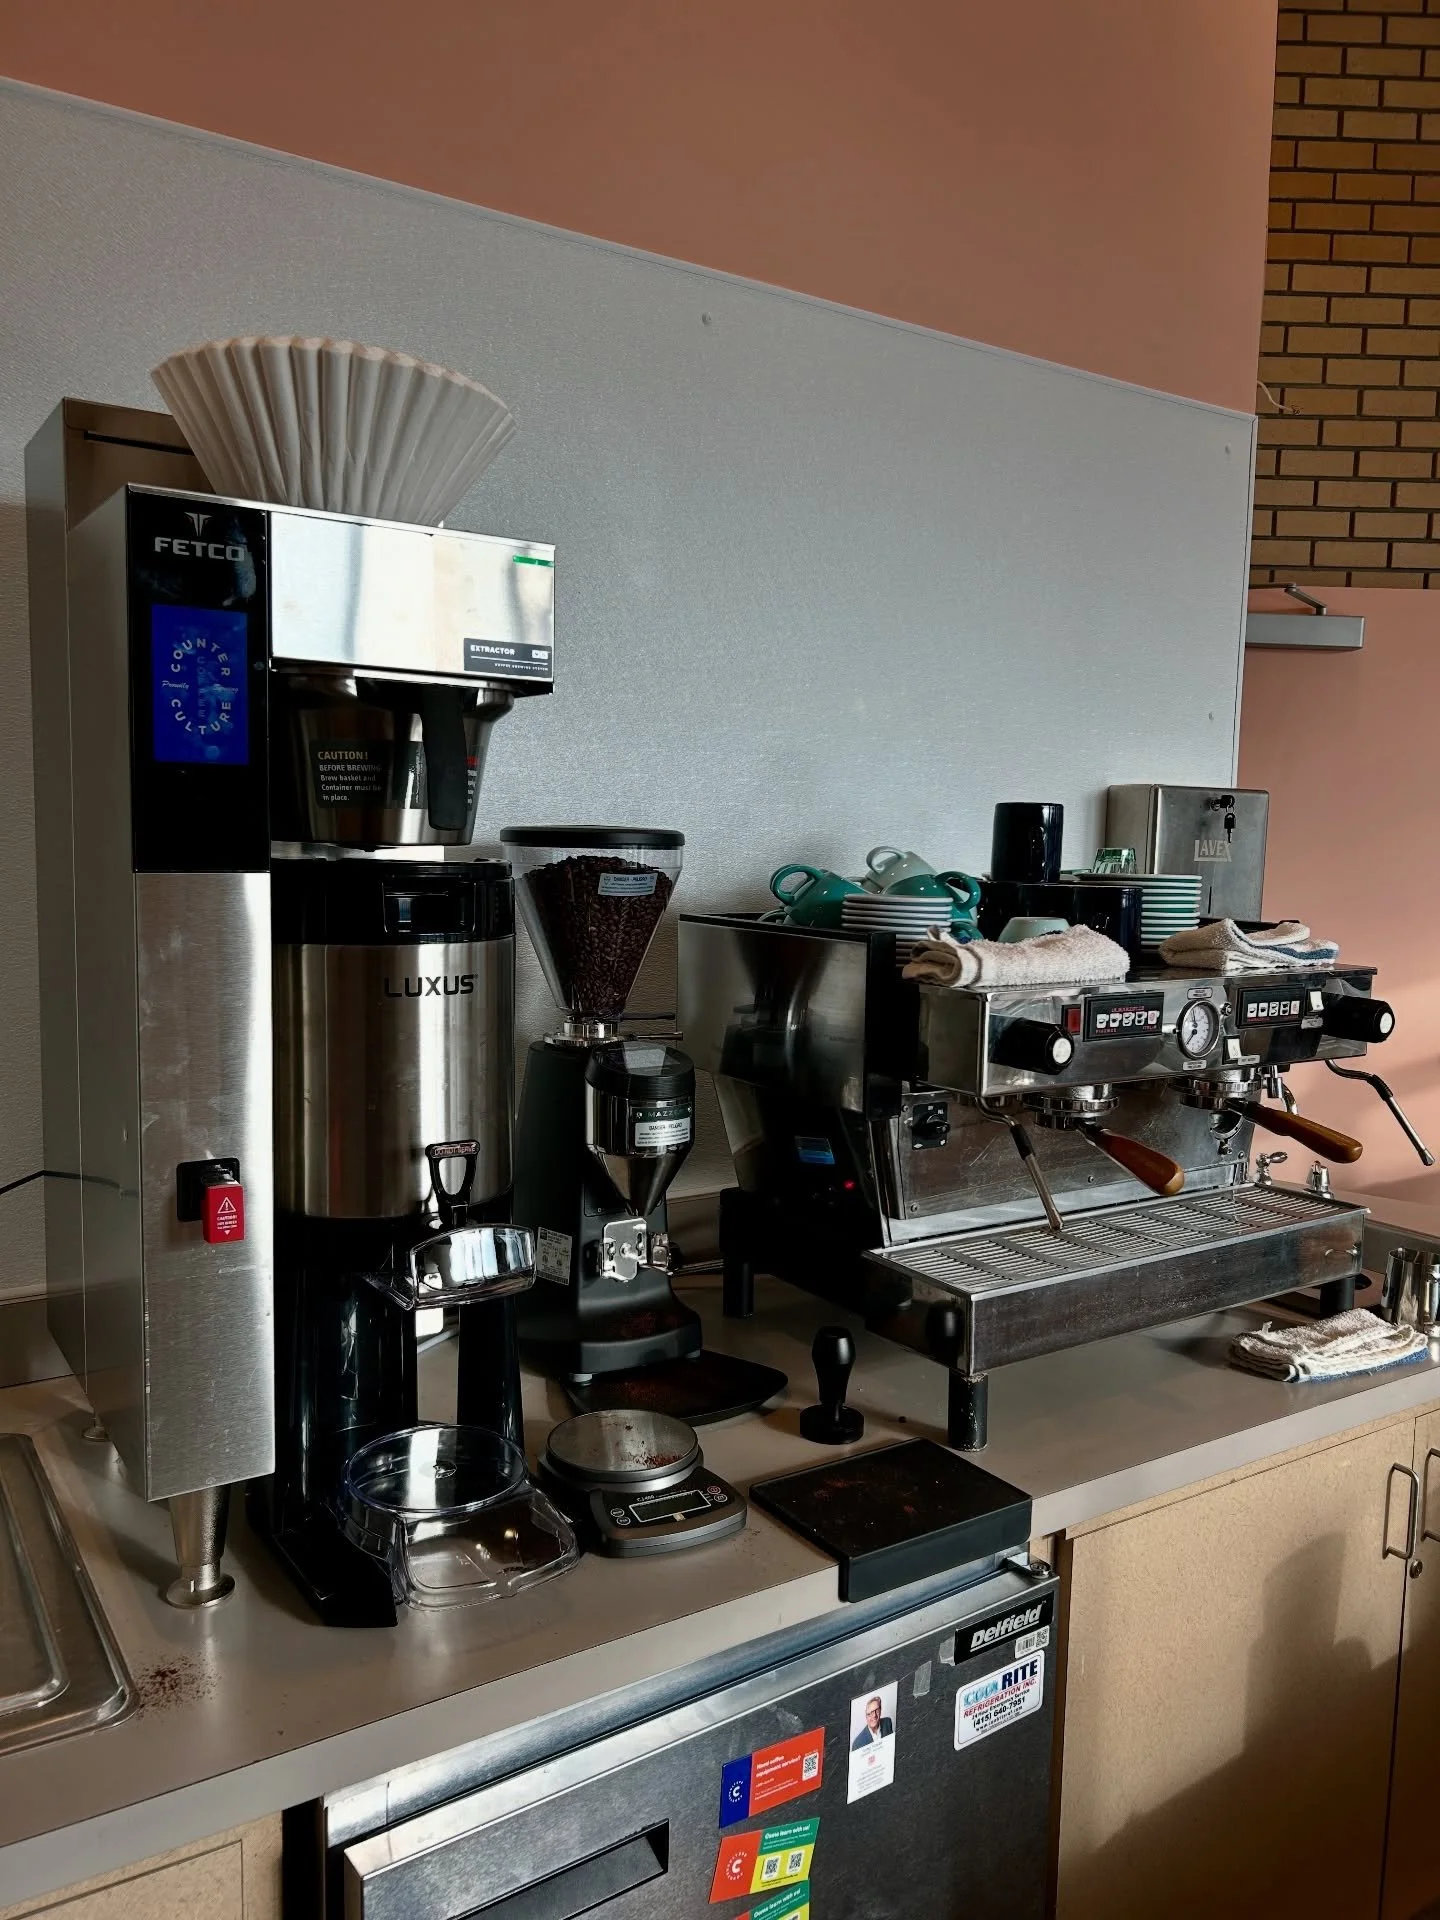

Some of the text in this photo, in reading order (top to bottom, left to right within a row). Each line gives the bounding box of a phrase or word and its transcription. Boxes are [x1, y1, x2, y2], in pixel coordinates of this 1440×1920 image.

[155, 536, 245, 561] FETCO
[170, 638, 231, 676] COUNTER
[470, 644, 516, 656] EXTRACTOR
[170, 698, 232, 735] CULTURE
[317, 751, 369, 760] CAUTION!
[319, 764, 346, 772] BEFORE
[320, 774, 338, 782] Brew
[339, 774, 362, 782] basket
[1194, 839, 1232, 862] LAVEX
[384, 974, 474, 998] LUXUS
[971, 1604, 1043, 1649] Delfield
[1002, 1659, 1038, 1691] RITE
[963, 1678, 1037, 1718] REFRIGERATION INC.
[973, 1710, 992, 1728] (415)
[993, 1696, 1026, 1717] 640-7951
